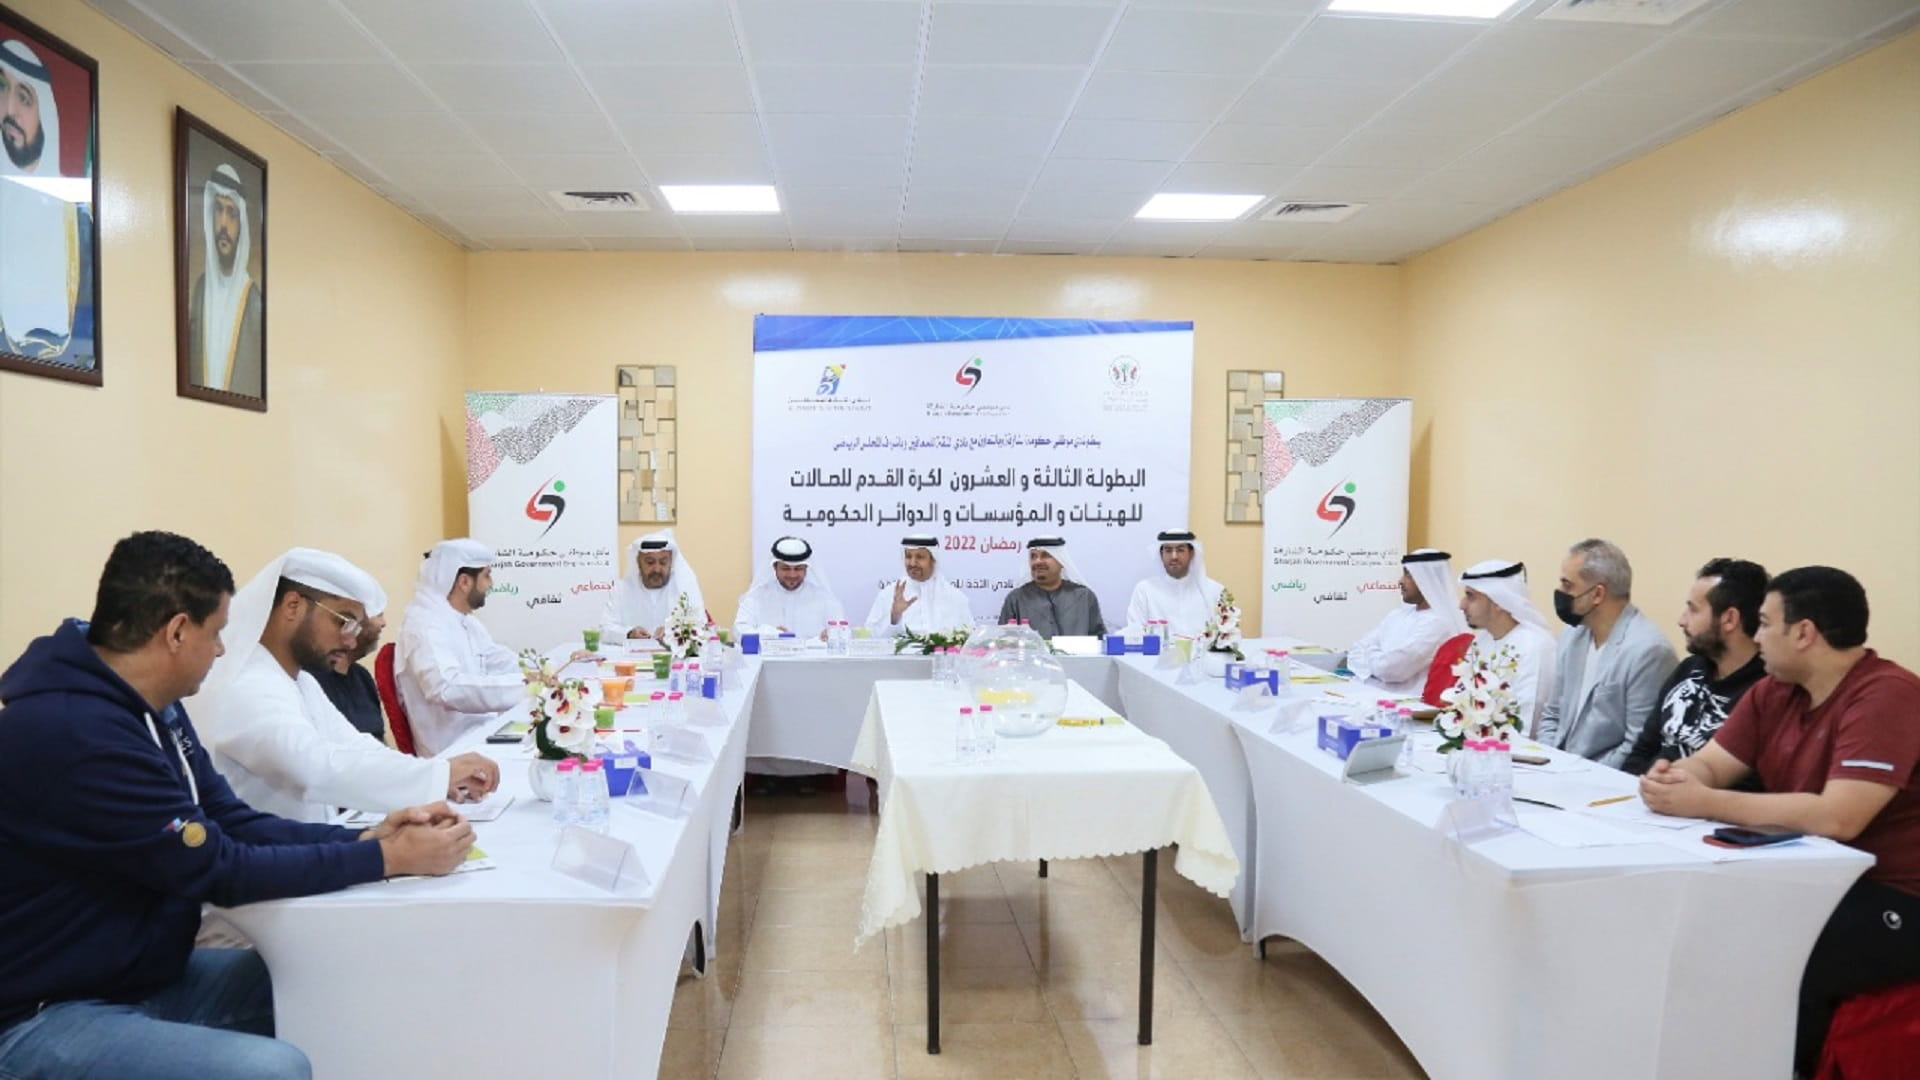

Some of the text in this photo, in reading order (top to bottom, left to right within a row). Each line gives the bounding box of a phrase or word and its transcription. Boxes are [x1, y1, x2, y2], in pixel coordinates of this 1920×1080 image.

[790, 465, 1146, 492] البطولة الثالثة و العشرون لكرة القدم للصالات
[782, 502, 1143, 527] للهيئات و المؤسسات و الدوائر الحكومية
[944, 535, 1022, 554] رمضان 2022
[1271, 579, 1306, 592] رياضي
[1313, 591, 1348, 604] ثقافي
